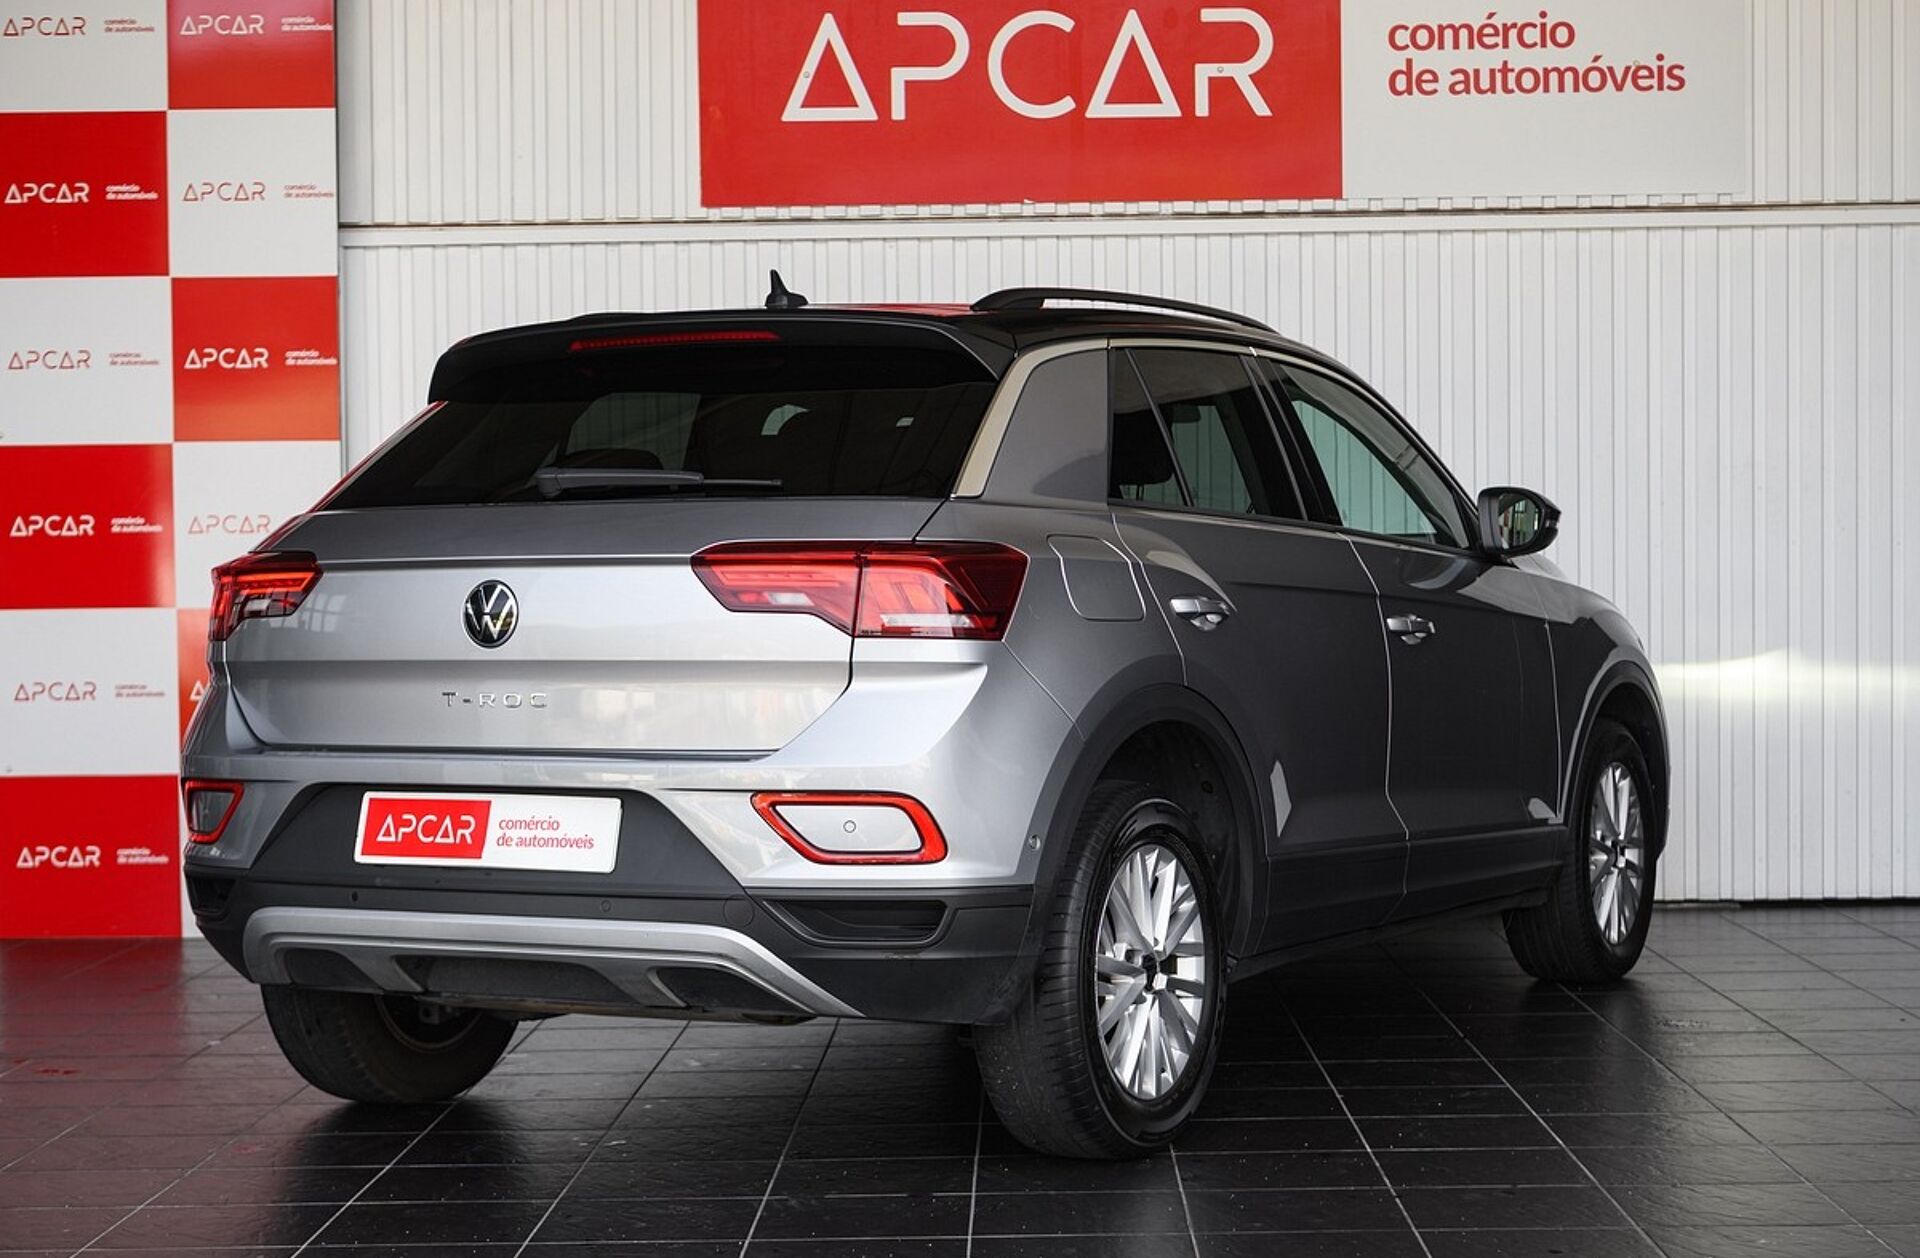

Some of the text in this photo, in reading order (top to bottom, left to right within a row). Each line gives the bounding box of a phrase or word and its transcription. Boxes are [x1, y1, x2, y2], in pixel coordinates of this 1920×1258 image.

[3, 17, 85, 36] APCAR
[180, 15, 264, 35] APCAR
[1387, 10, 1576, 51] comércio
[781, 8, 1274, 121] APCAR
[1387, 53, 1686, 96] de automóveis
[5, 183, 89, 203] APCAR
[183, 182, 265, 201] APCAR
[8, 350, 90, 370] APCAR
[184, 347, 268, 369] APCAR
[10, 515, 94, 536] APCAR
[188, 514, 270, 534] APCAR
[14, 682, 96, 701] APCAR
[442, 691, 548, 708] T-ROC
[376, 813, 476, 844] APCAR
[498, 815, 560, 831] comércio
[496, 832, 594, 849] de automóveis
[17, 846, 100, 868] APCAR
